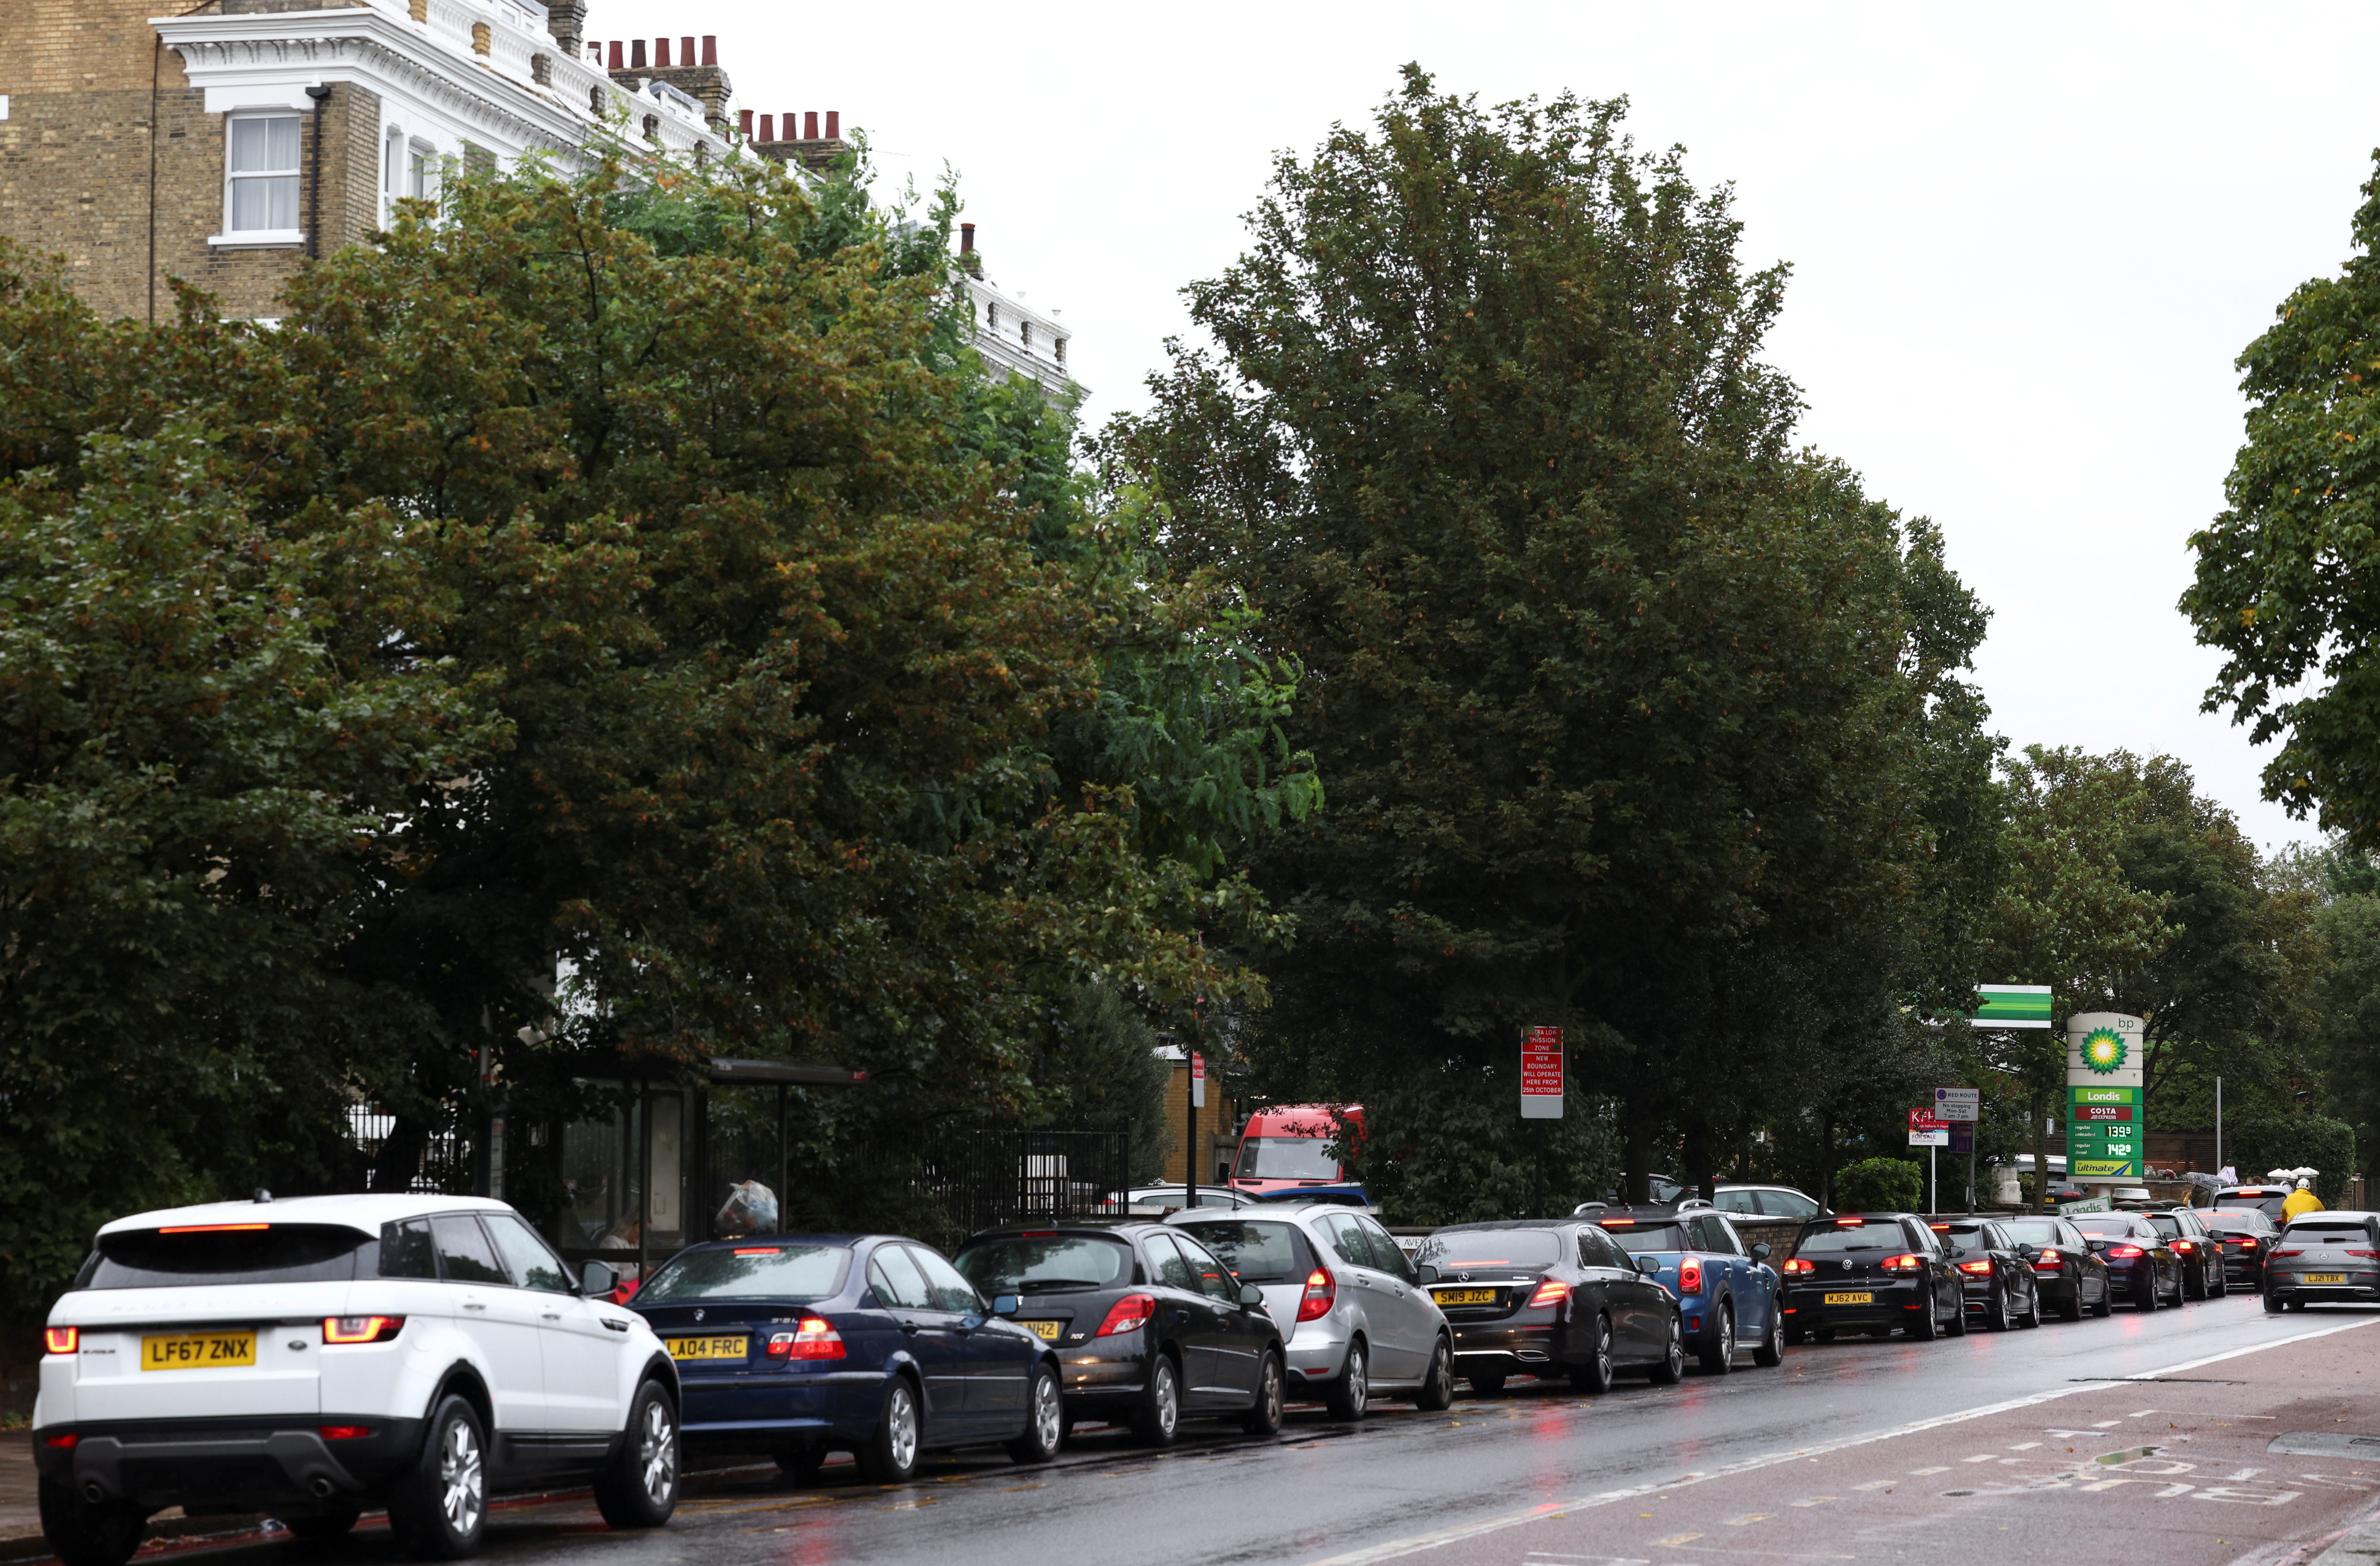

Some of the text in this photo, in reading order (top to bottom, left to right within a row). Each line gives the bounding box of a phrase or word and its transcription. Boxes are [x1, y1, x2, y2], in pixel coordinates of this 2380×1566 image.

[2119, 1017, 2134, 1030] bp
[2087, 1091, 2120, 1101] Londis
[1441, 1290, 1489, 1303] SM19 JZC
[1027, 1322, 1055, 1335] NHZ
[152, 1338, 249, 1362] LF67 ZNX
[667, 1339, 743, 1356] LA04 FRC
